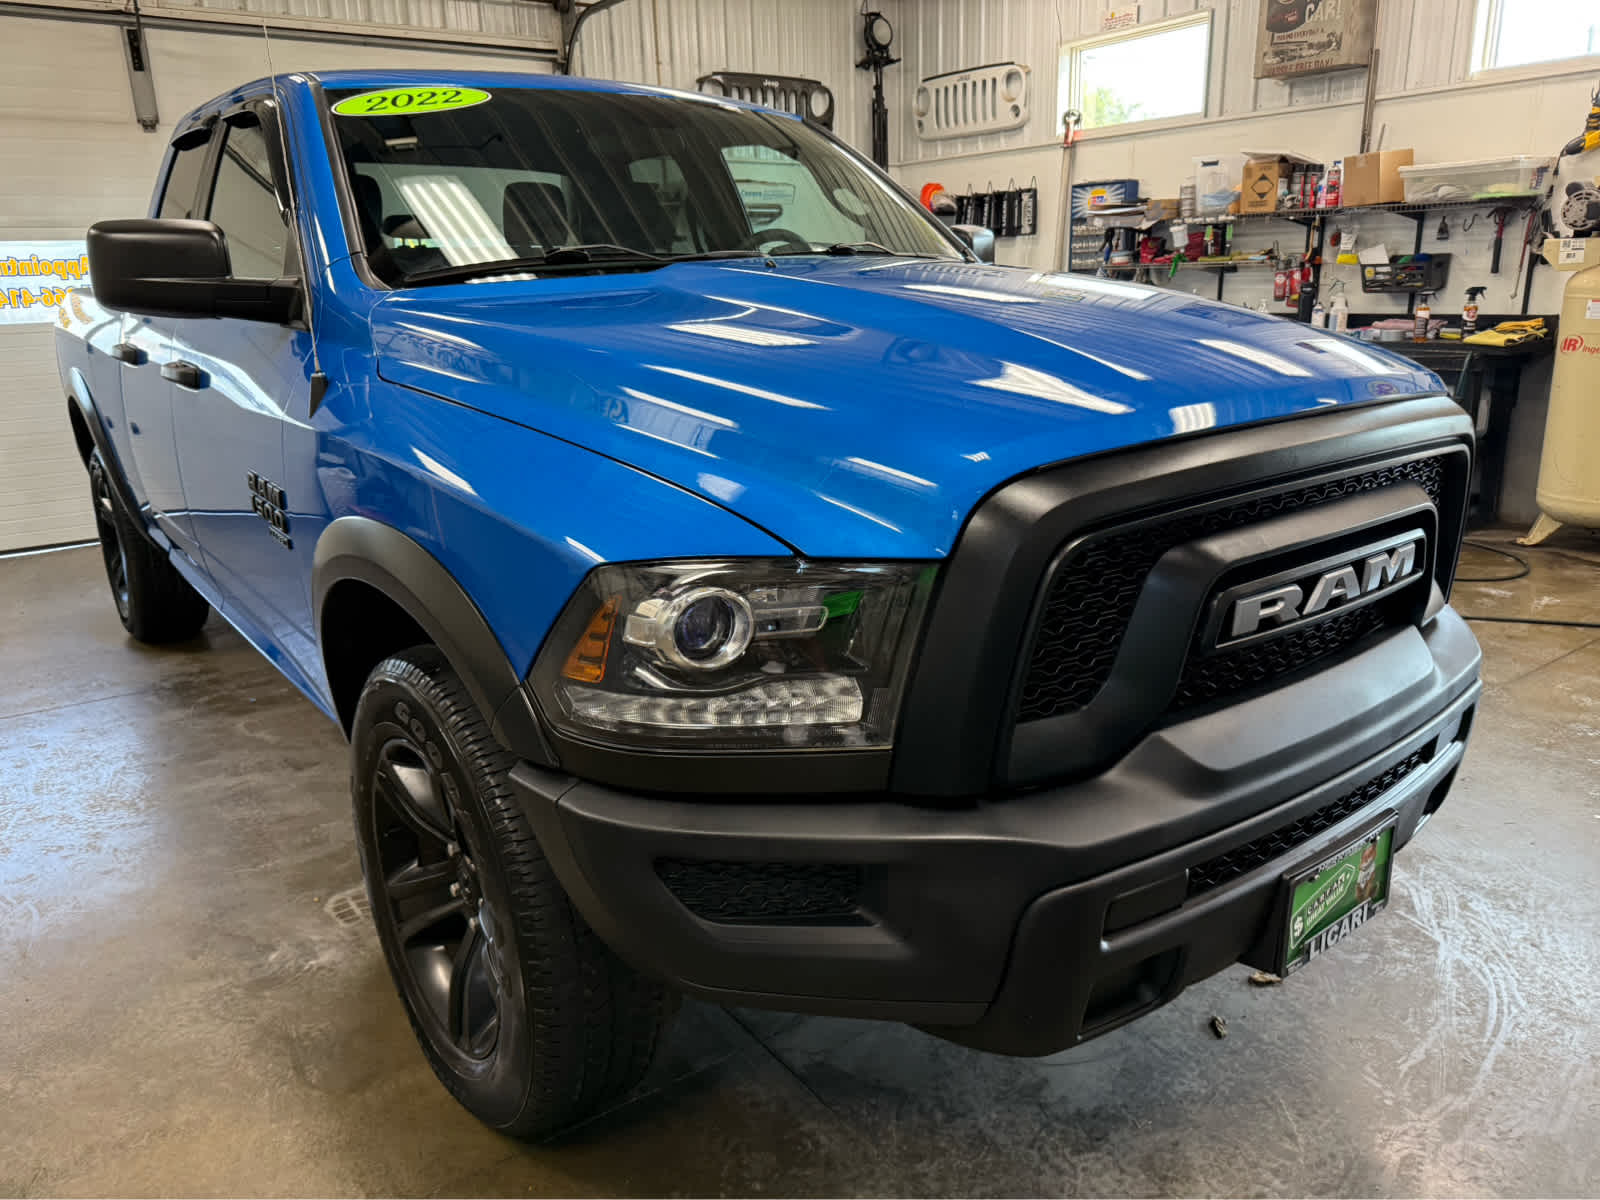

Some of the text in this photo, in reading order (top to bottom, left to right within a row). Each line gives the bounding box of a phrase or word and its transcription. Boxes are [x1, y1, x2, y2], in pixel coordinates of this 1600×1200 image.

[366, 90, 463, 113] 2022
[1562, 336, 1580, 352] IR
[1231, 542, 1417, 637] RAM
[1309, 903, 1369, 961] LICARI
